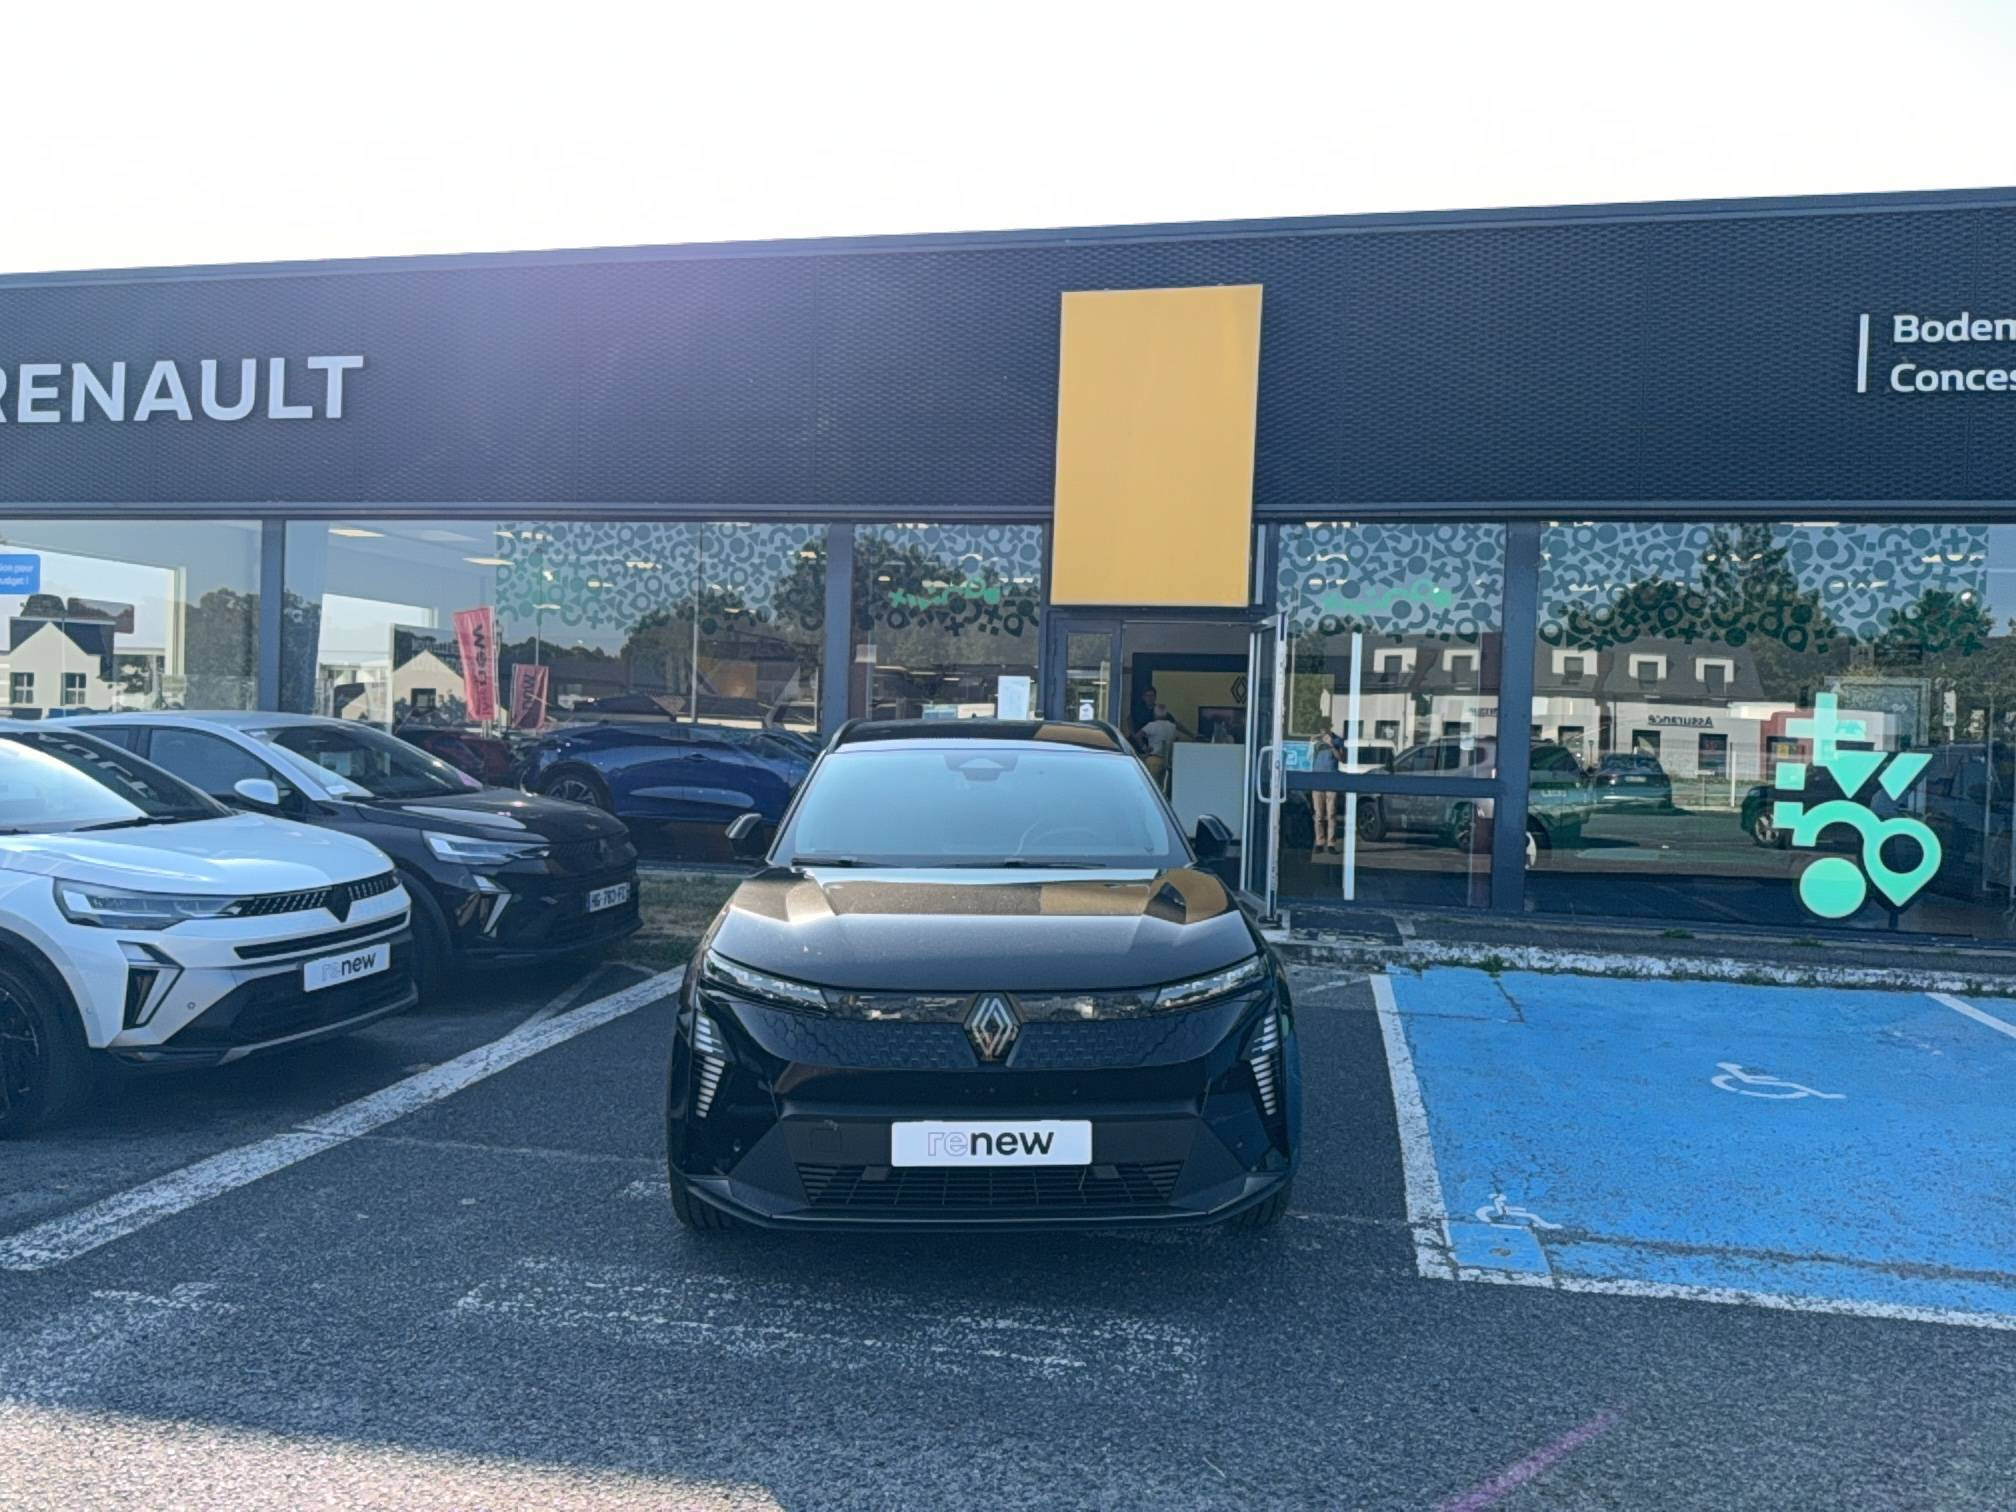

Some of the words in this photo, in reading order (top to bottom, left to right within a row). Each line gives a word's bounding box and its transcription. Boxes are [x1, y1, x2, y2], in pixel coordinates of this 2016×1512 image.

[0, 355, 364, 423] ENAULT
[321, 952, 376, 982] renew
[928, 1132, 1054, 1156] renew
